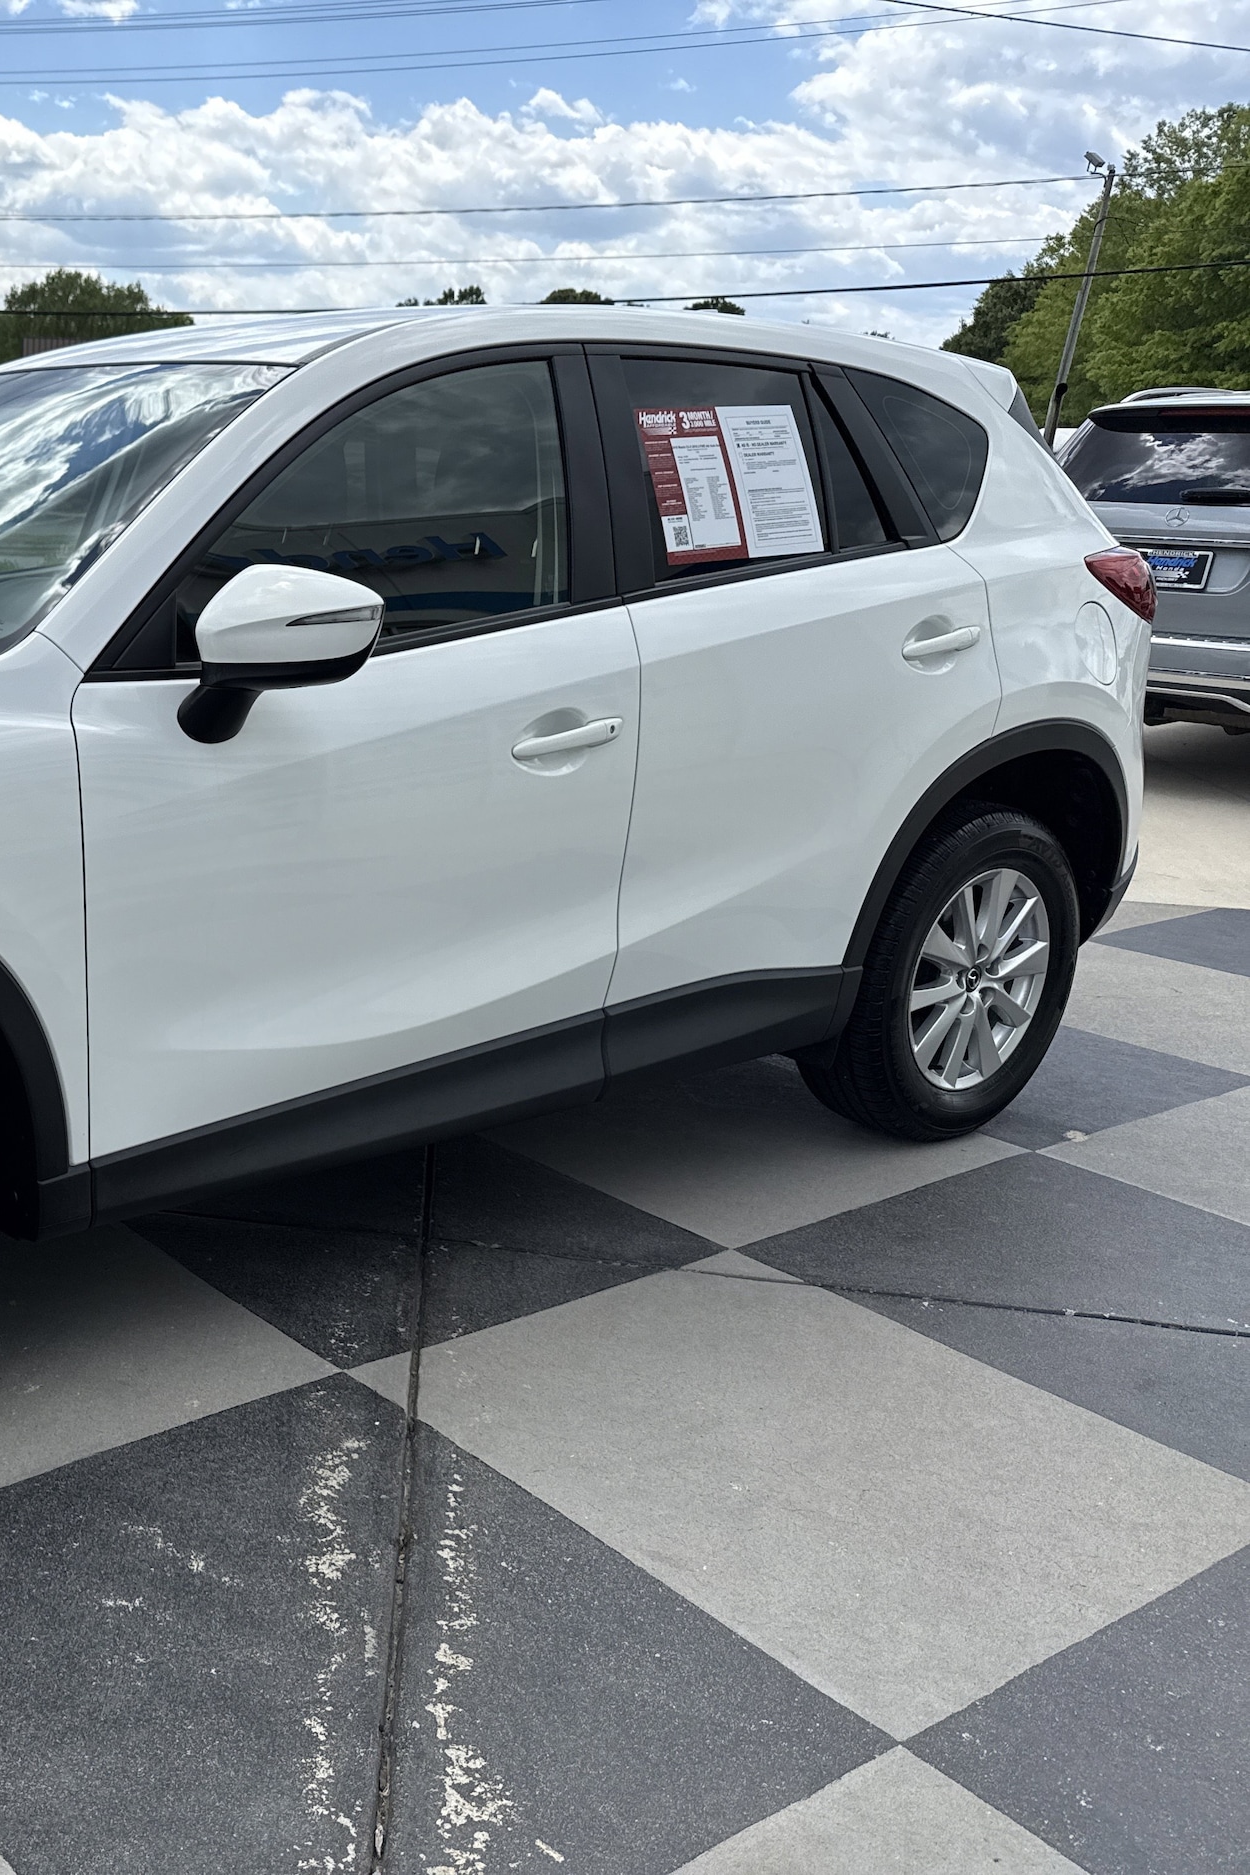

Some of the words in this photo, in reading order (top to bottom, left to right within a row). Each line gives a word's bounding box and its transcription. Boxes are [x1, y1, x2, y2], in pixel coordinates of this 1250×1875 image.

[638, 410, 677, 428] Hendrick
[679, 411, 690, 429] 3
[1147, 556, 1198, 567] Hendrick
